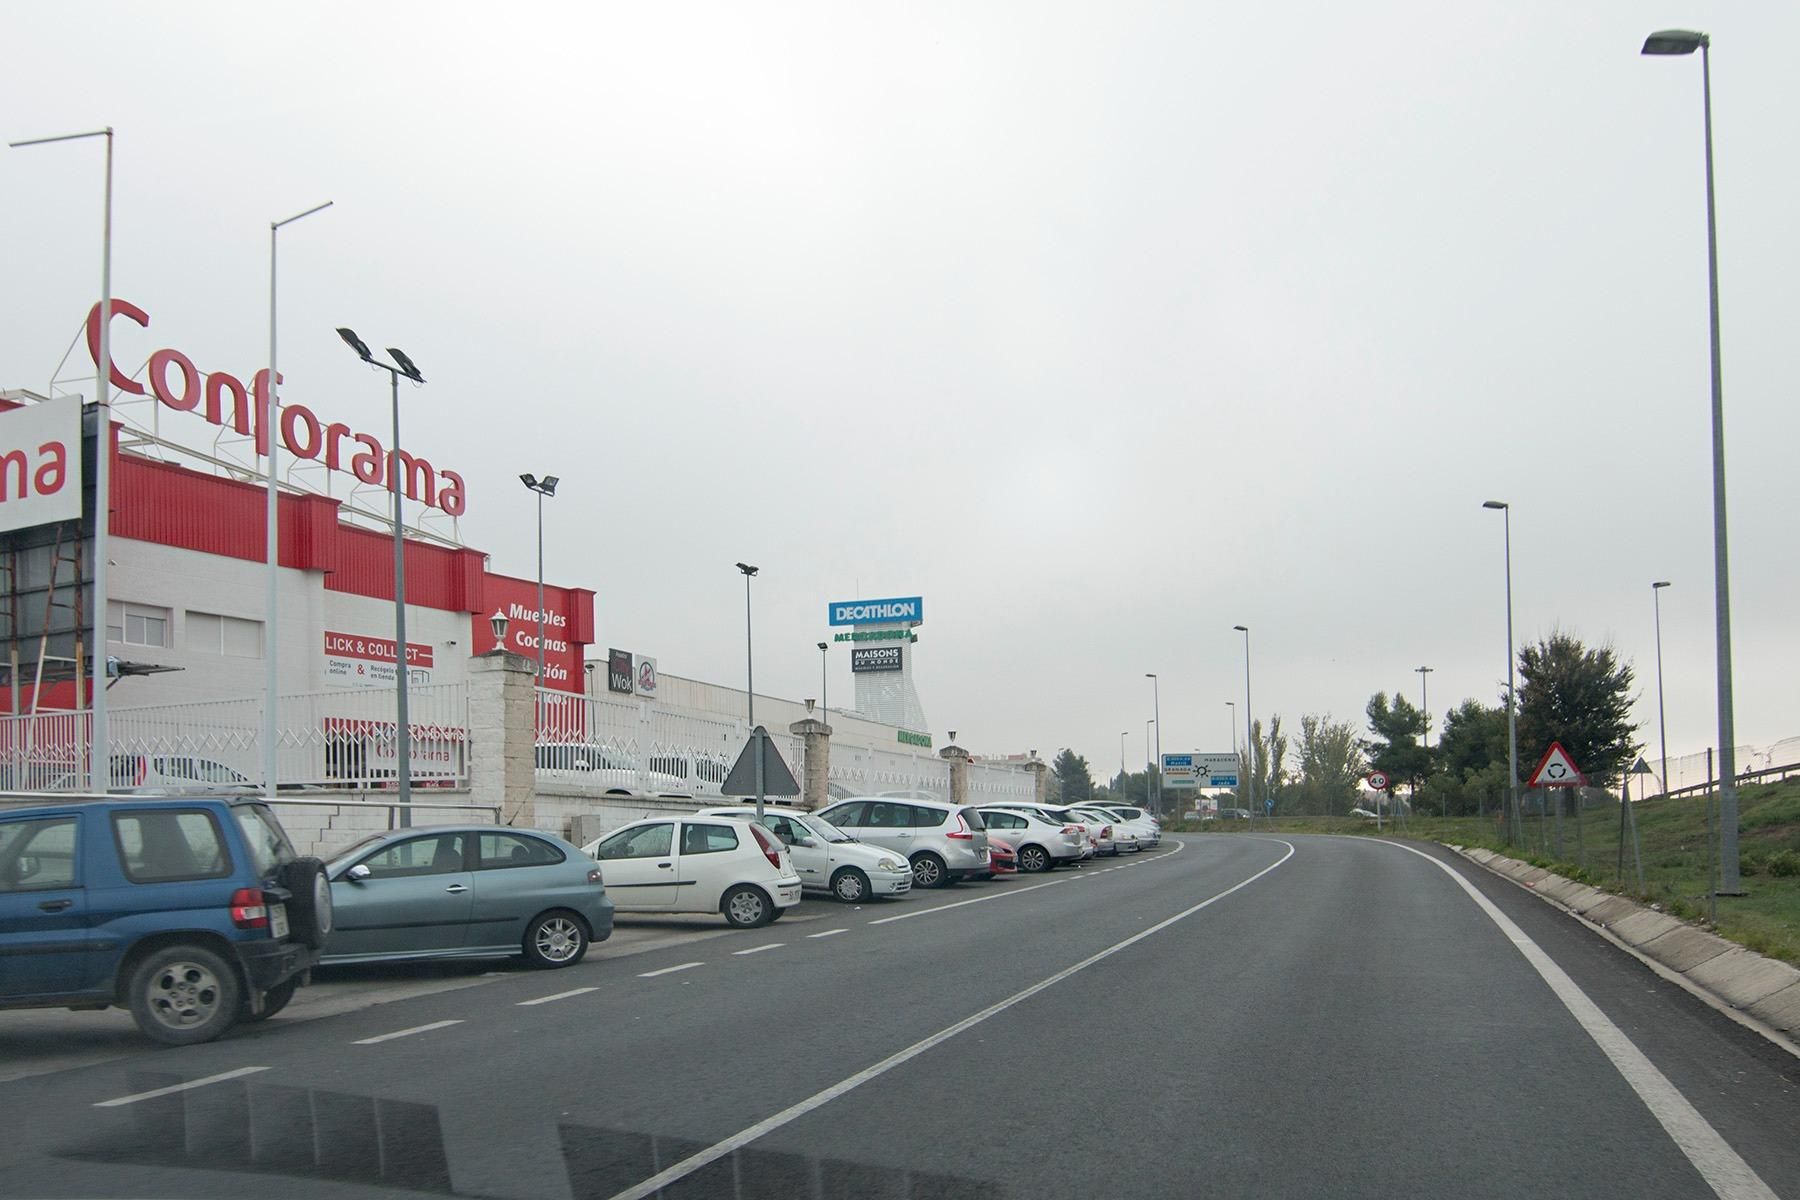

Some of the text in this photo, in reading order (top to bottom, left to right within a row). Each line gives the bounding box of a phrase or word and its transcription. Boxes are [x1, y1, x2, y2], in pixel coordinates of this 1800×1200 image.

[87, 298, 465, 517] Conforama
[836, 602, 915, 621] DECATHLON
[357, 641, 365, 654] &
[368, 643, 418, 660] COLLCT
[516, 631, 567, 652] Cocnas
[855, 649, 899, 659] MAISONS
[357, 664, 365, 675] &
[612, 673, 633, 690] Wok
[1371, 777, 1384, 785] 40
